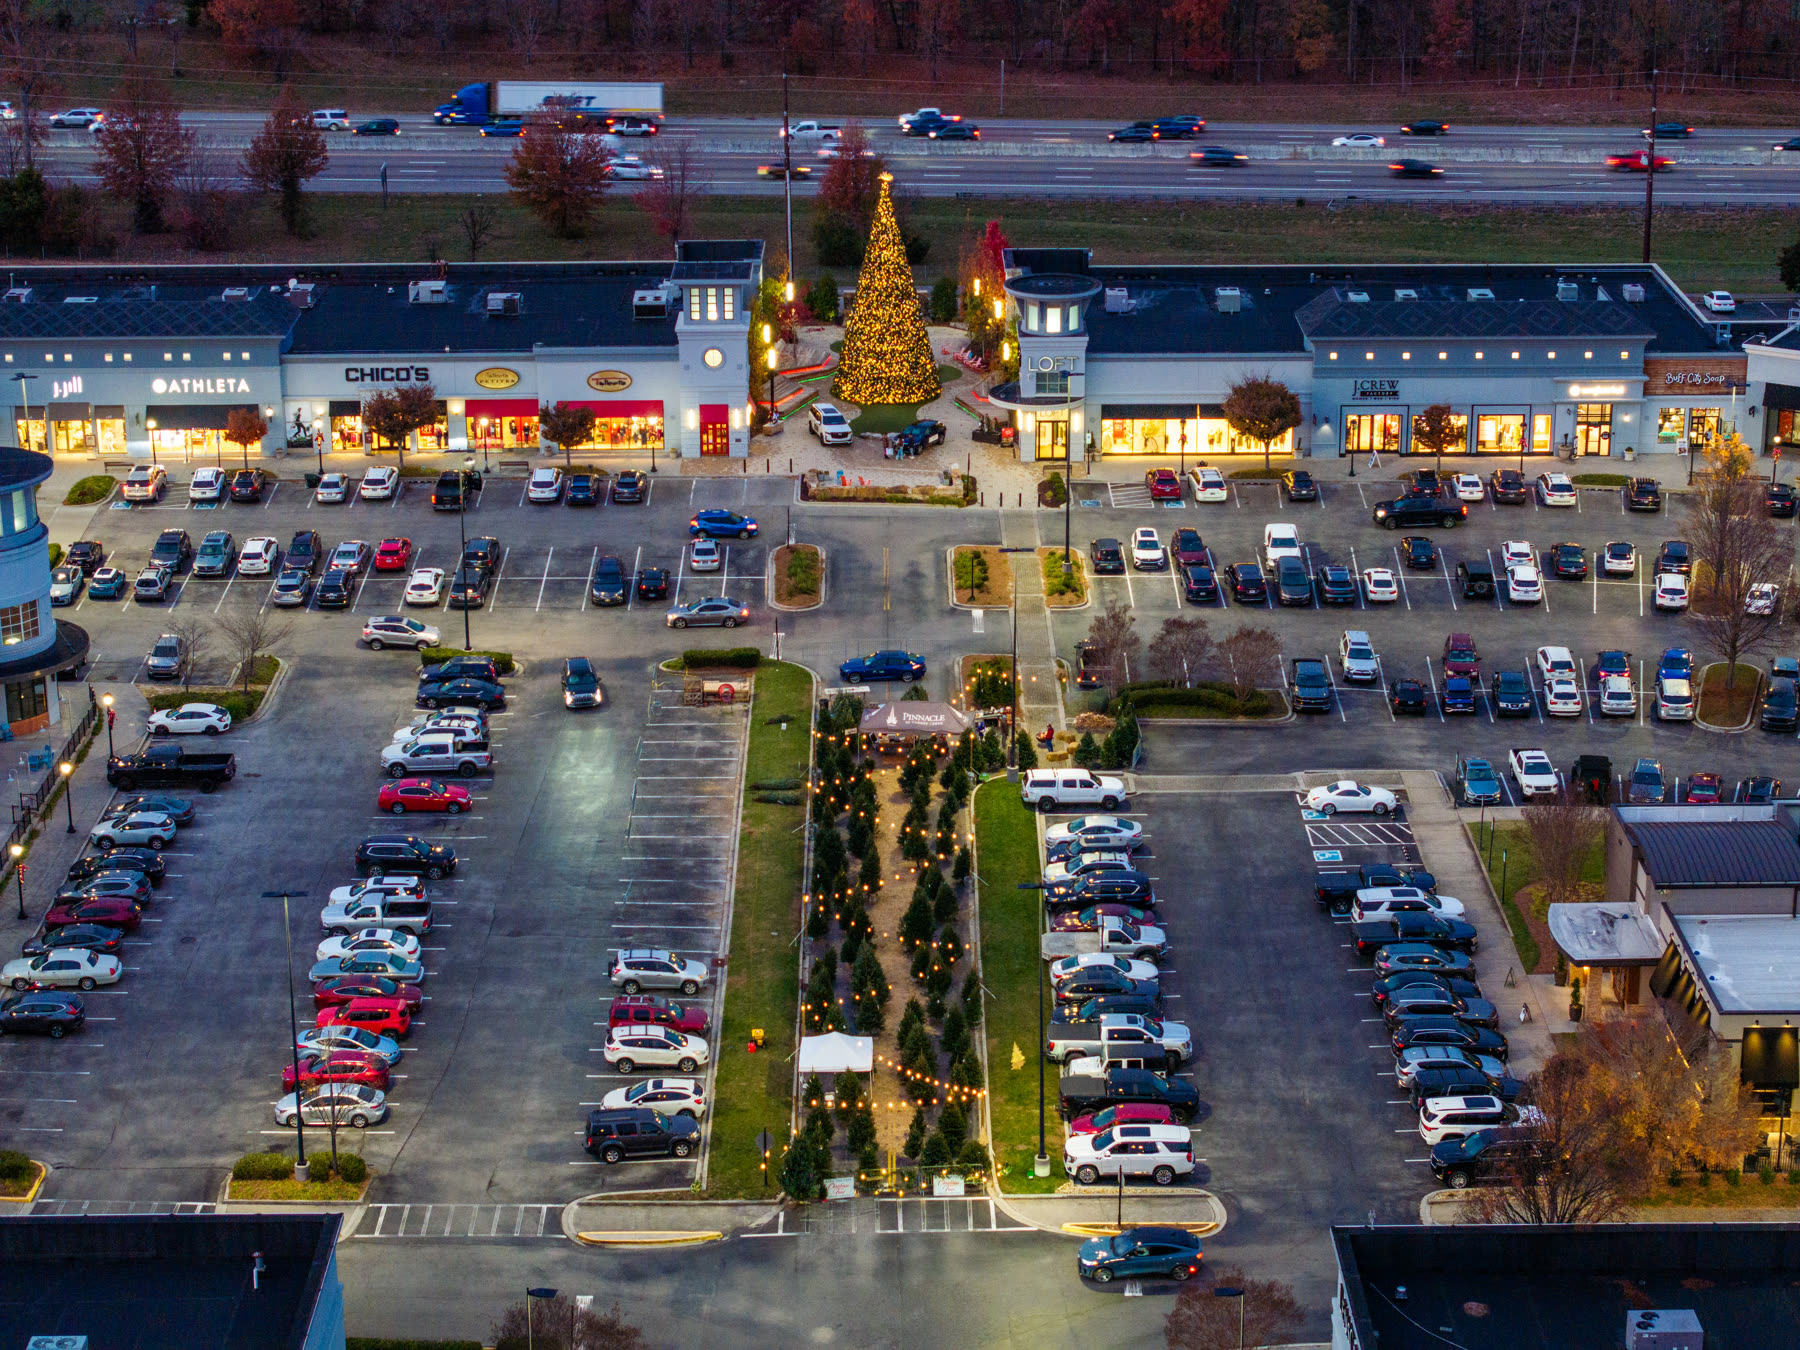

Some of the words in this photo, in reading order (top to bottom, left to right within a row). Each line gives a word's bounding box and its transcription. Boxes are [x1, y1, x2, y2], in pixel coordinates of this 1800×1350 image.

[1028, 356, 1080, 372] LOFT
[345, 365, 430, 382] CHICO'S
[1665, 372, 1686, 384] Buff
[1687, 372, 1702, 385] City
[1703, 372, 1726, 385] Soap
[168, 378, 251, 394] ATHLETA
[1352, 380, 1399, 396] J.CREW
[903, 712, 945, 722] PINNACLE
